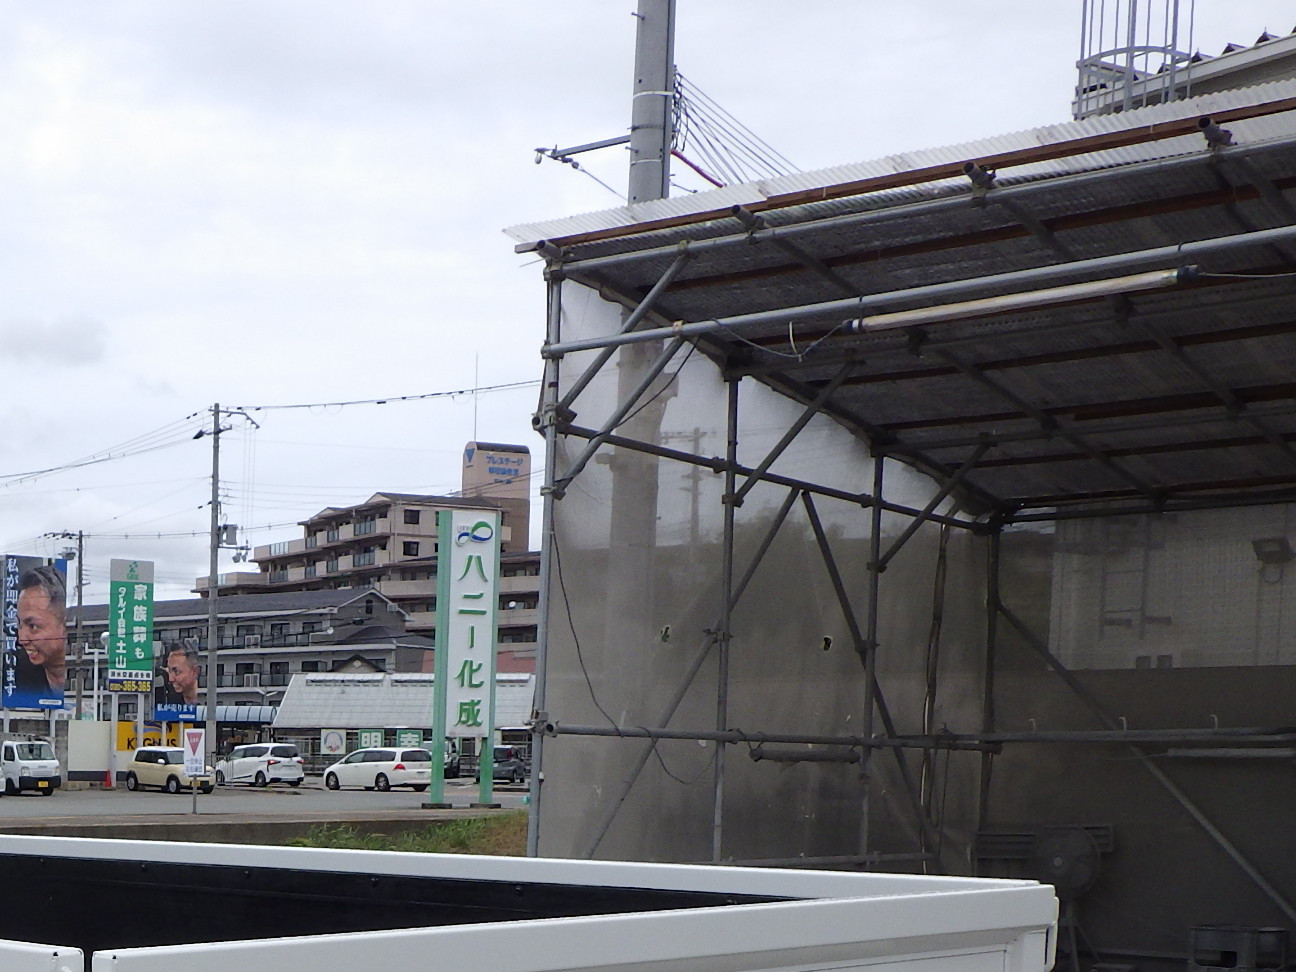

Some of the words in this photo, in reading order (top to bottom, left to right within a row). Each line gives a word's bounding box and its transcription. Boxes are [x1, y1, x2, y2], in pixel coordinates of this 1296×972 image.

[4, 557, 19, 697] 私が即金で買います
[133, 584, 147, 659] 家族葬も
[455, 555, 488, 727] ハニー化成
